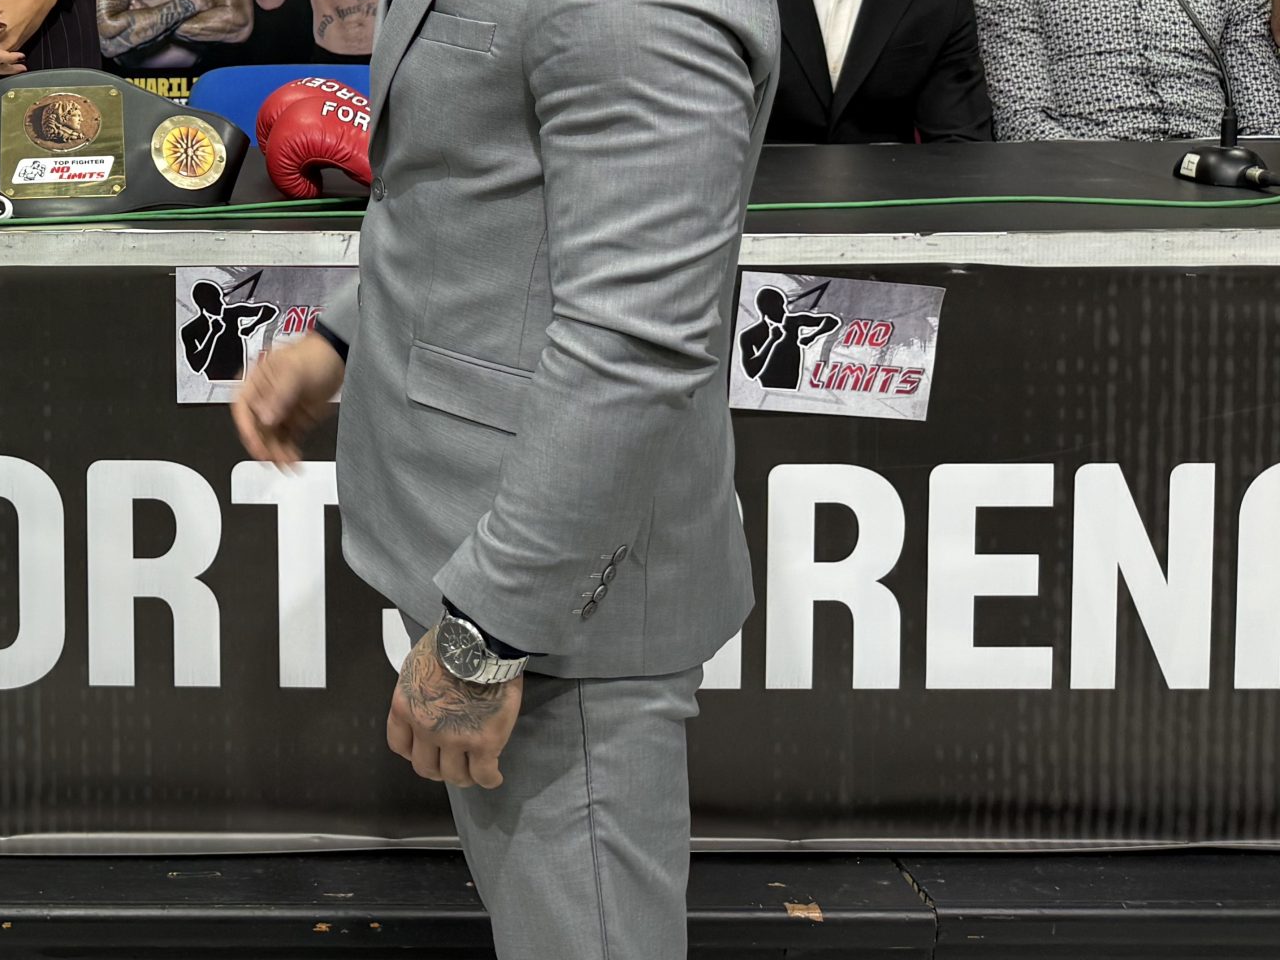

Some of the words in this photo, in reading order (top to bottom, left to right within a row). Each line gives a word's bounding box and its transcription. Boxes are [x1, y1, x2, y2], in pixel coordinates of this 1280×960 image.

[50, 166, 71, 174] NO
[59, 171, 106, 180] LIMITS
[840, 317, 896, 349] NO
[808, 359, 926, 396] LIMITS
